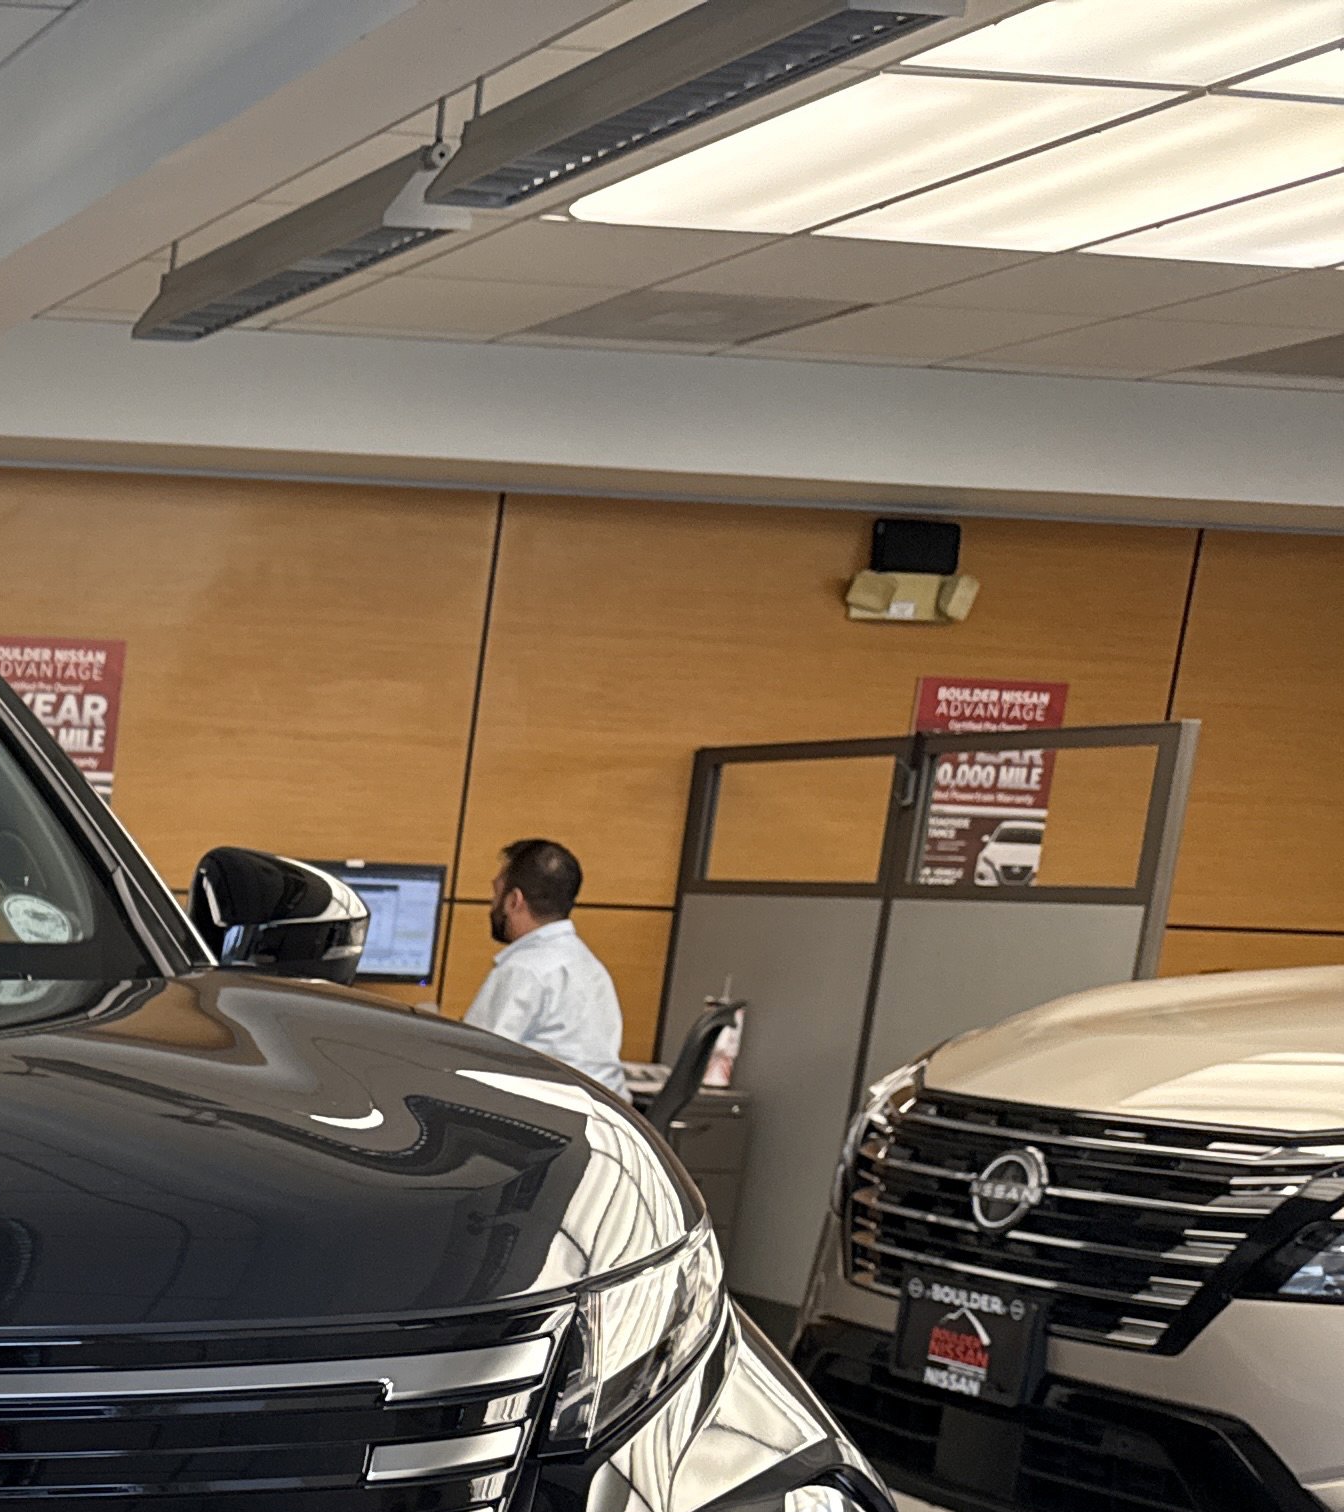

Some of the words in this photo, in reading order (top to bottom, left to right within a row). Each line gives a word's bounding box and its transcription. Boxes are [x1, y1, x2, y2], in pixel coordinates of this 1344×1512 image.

[53, 648, 107, 665] NISSAN
[937, 685, 1001, 703] BOULDER
[1000, 688, 1052, 706] NISSAN
[934, 700, 1048, 722] ADVANTAGE
[57, 727, 107, 753] MILE
[935, 761, 996, 788] 0,000
[996, 765, 1045, 791] MILE
[970, 1181, 1043, 1206] NISSAN
[931, 1282, 1004, 1315] BOULDER
[922, 1365, 981, 1398] NISSAN
